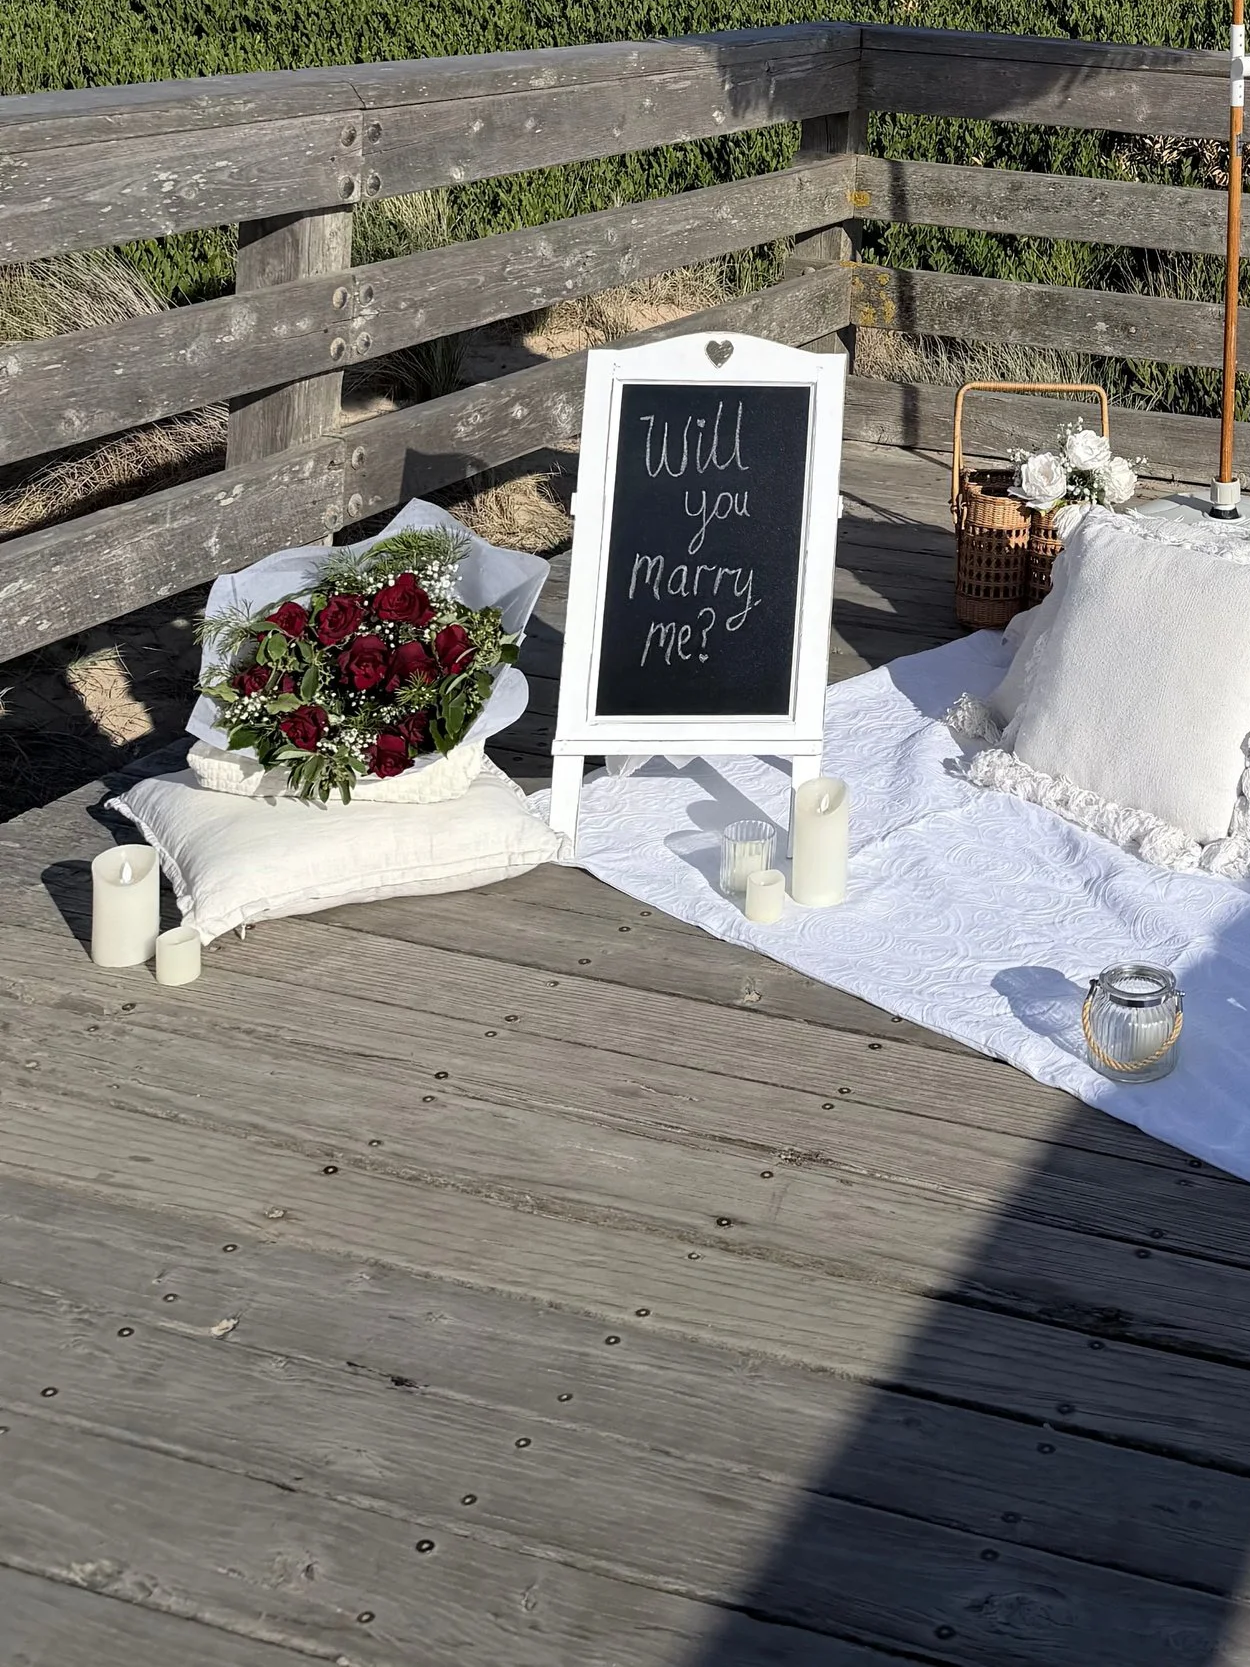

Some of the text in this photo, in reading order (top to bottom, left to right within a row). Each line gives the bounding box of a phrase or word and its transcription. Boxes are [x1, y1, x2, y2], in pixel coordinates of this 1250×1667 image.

[640, 401, 750, 478] Will
[684, 490, 751, 555] you
[640, 607, 716, 668] me?
